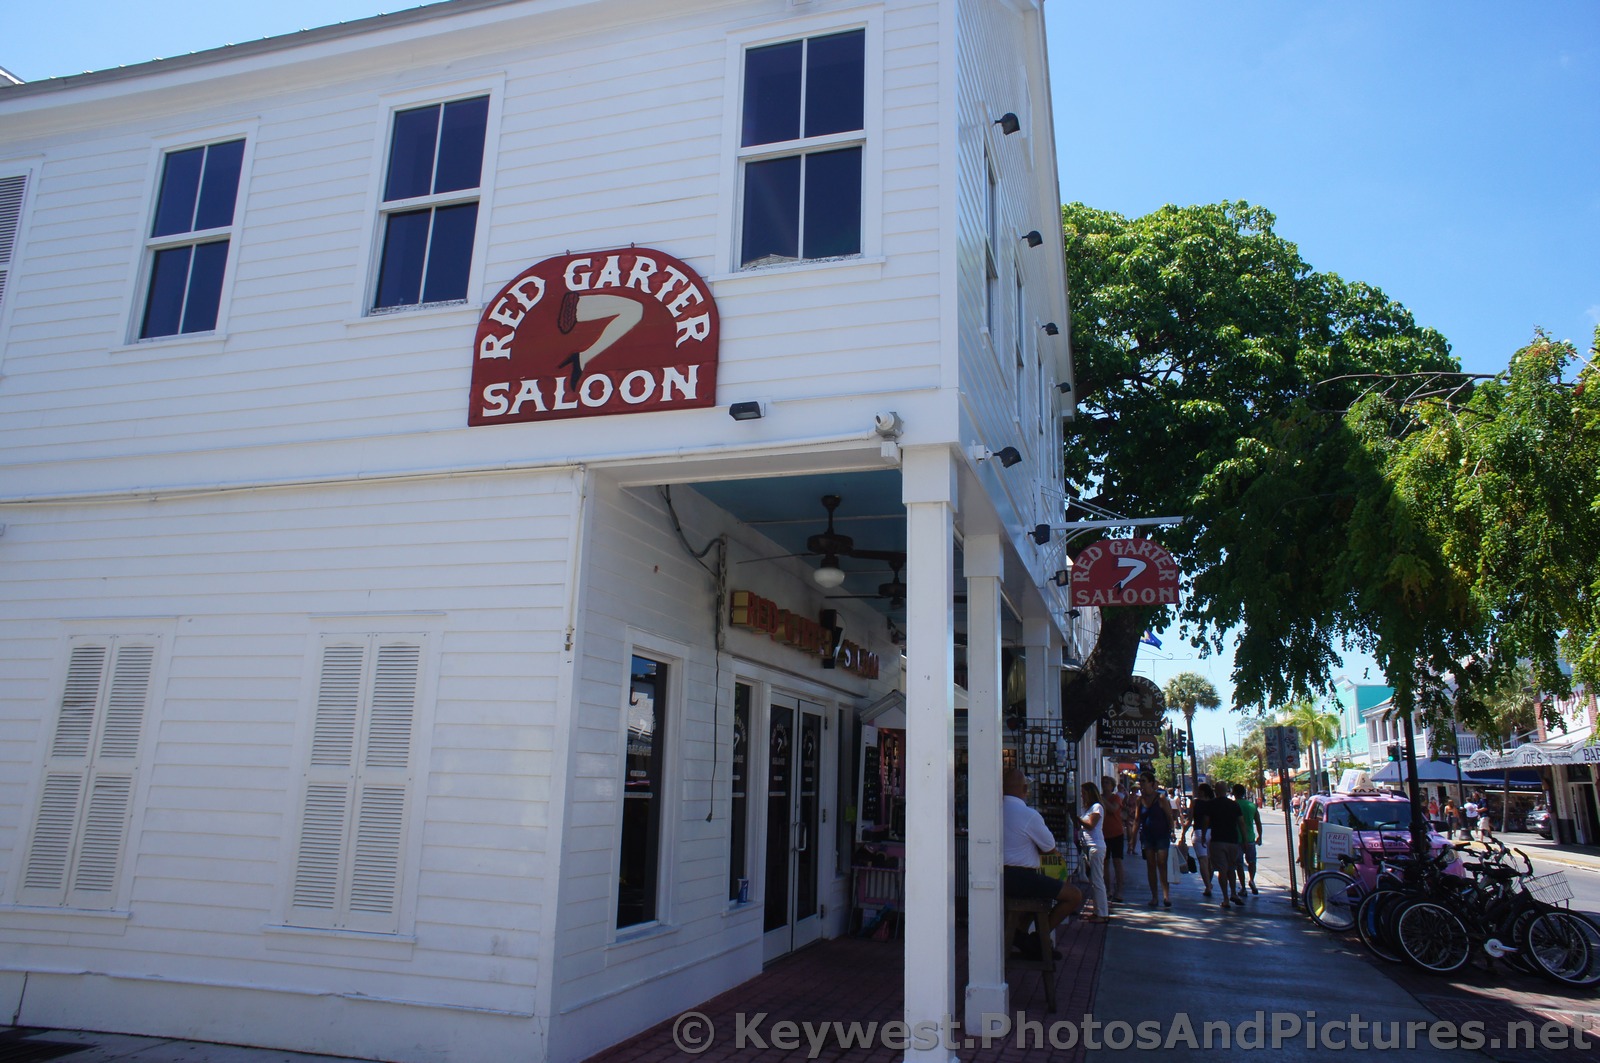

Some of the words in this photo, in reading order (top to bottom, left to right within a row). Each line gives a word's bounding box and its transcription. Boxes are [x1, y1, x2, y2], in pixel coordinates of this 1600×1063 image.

[480, 275, 546, 360] RED
[563, 255, 711, 349] GARTER
[482, 364, 700, 417] SALOON
[1073, 546, 1103, 583] RED
[1108, 540, 1177, 581] GARTER
[1076, 587, 1176, 605] SALOON
[1111, 719, 1130, 728] KEY
[1132, 719, 1160, 728] WEST
[1112, 727, 1125, 735] 208
[1125, 727, 1151, 735] DUVAL
[1041, 855, 1062, 866] MADE
